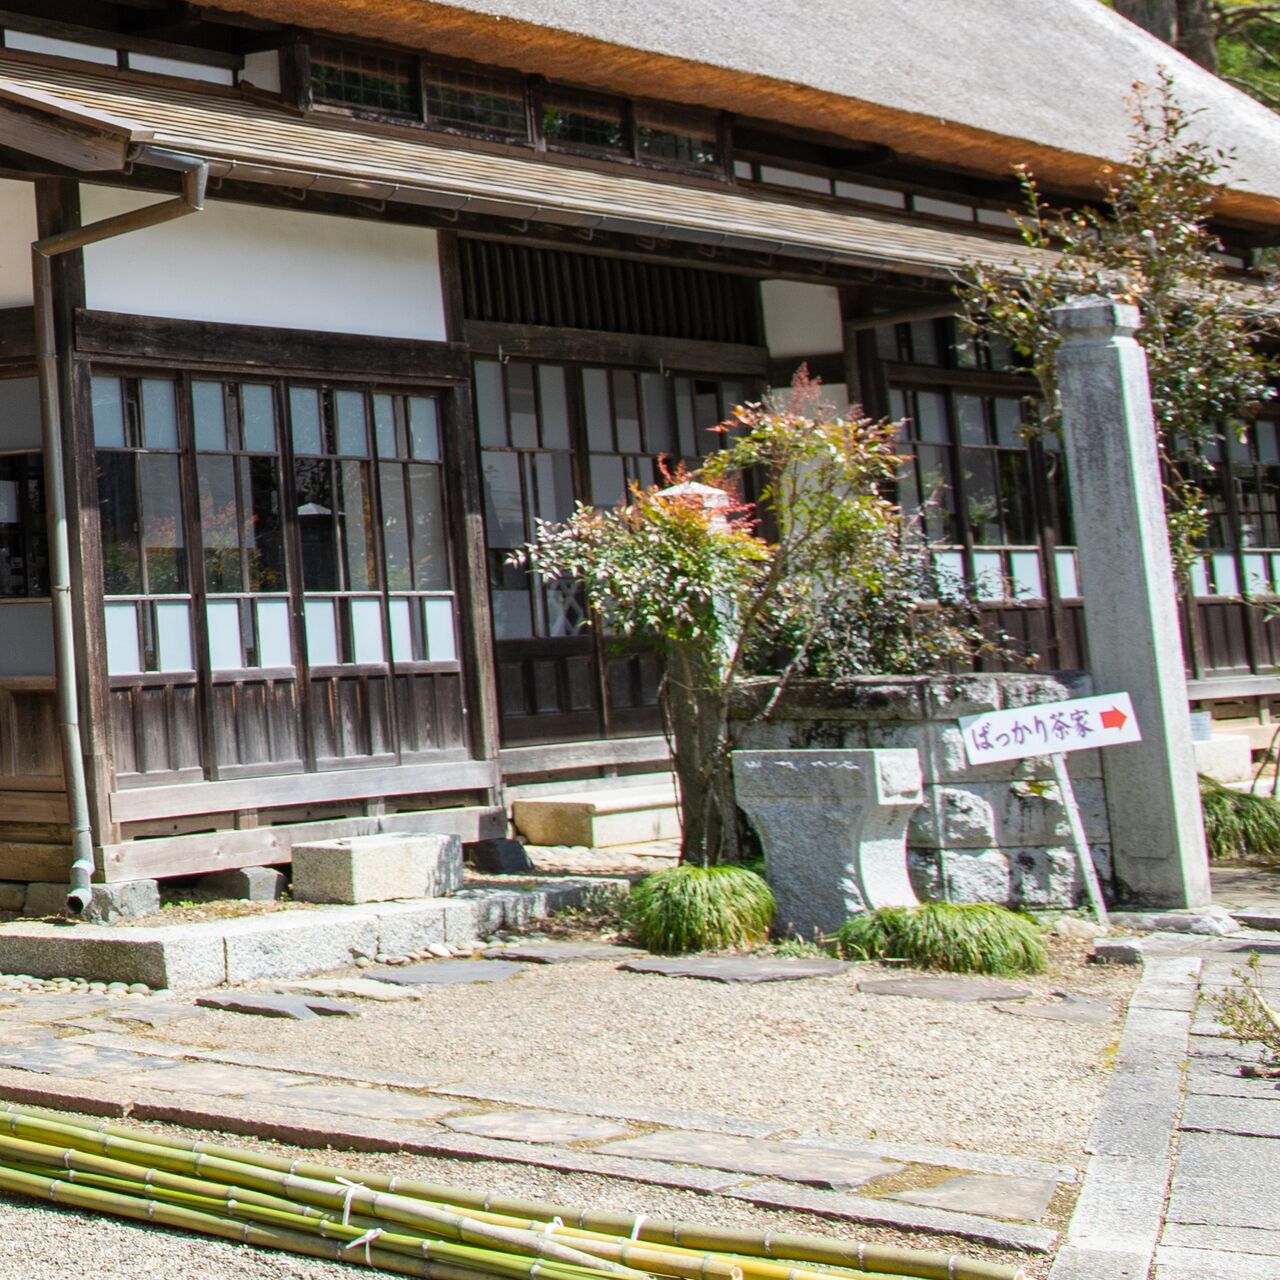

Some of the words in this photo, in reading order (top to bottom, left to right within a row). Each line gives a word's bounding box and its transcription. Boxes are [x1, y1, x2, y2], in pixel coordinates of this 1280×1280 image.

[971, 708, 1094, 751] ばっかり茶家
